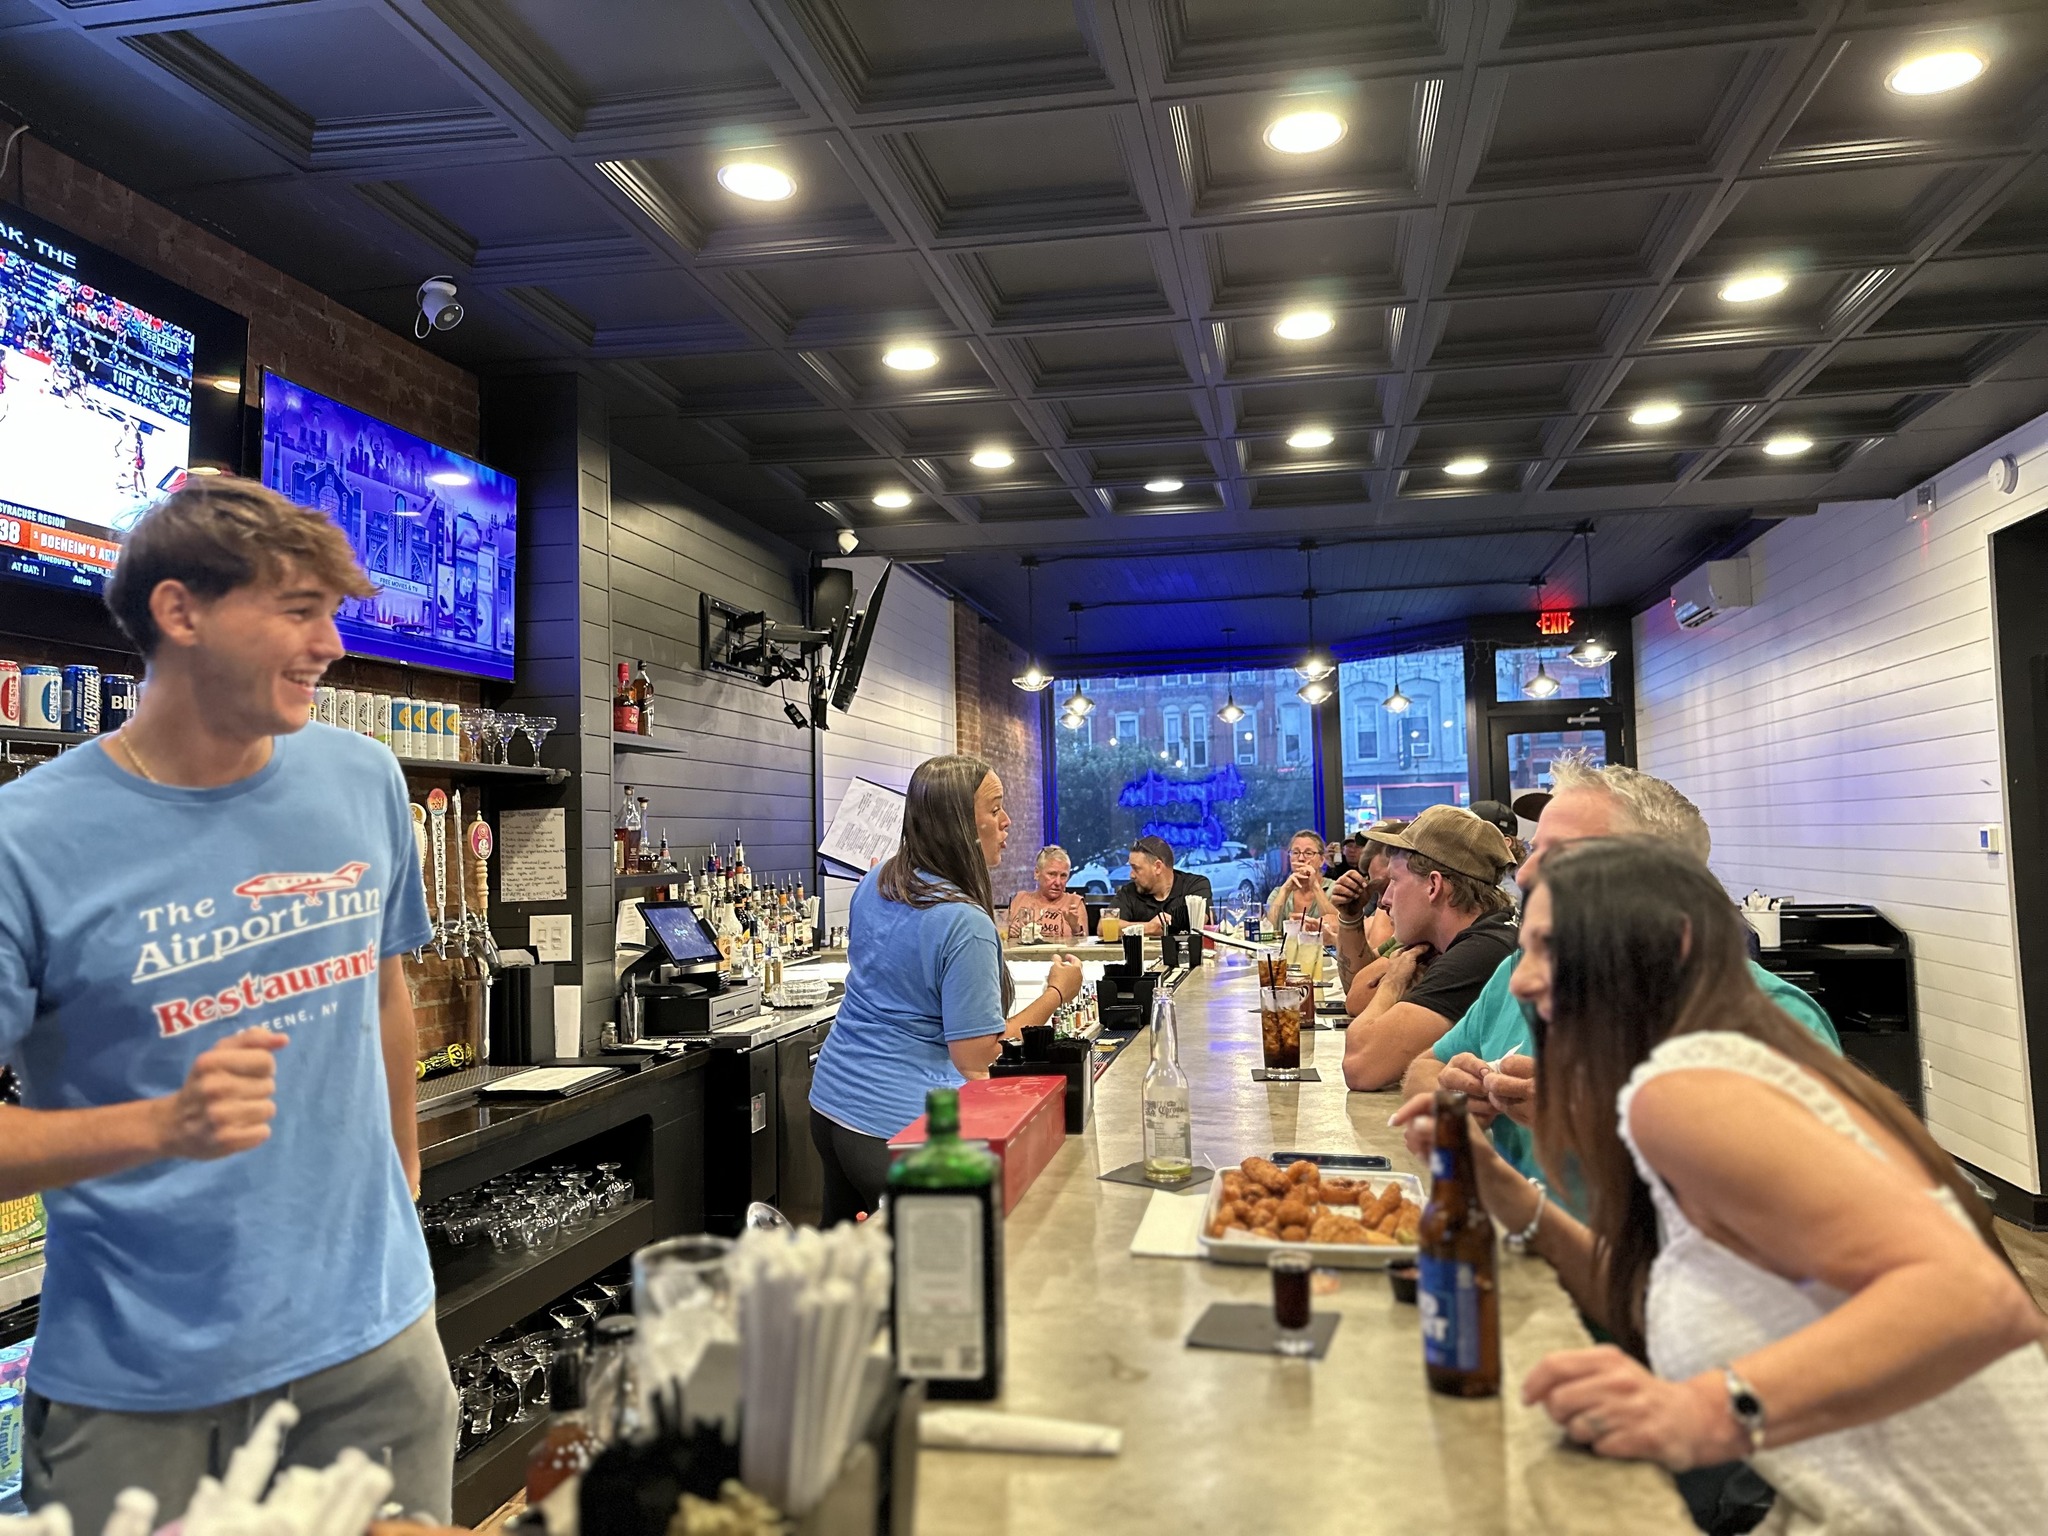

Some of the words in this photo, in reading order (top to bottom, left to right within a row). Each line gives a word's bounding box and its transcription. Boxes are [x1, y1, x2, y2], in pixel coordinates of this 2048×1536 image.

[34, 238, 76, 269] THE
[112, 369, 134, 391] THE
[0, 502, 37, 521] SYRACUSE
[37, 512, 66, 529] REGION
[41, 533, 97, 558] BOEHEIM'S
[11, 561, 22, 571] AT
[22, 564, 39, 576] BAT:
[1541, 612, 1570, 634] EXIT
[49, 680, 59, 721] GENESEE
[83, 672, 99, 728] KEYSTONE
[139, 897, 216, 933] The
[1041, 923, 1059, 932] see
[133, 900, 309, 977] Airport
[326, 887, 380, 919] Inn
[153, 939, 377, 1038] Restaurant
[321, 1001, 338, 1016] NY
[2, 1205, 36, 1234] BEER
